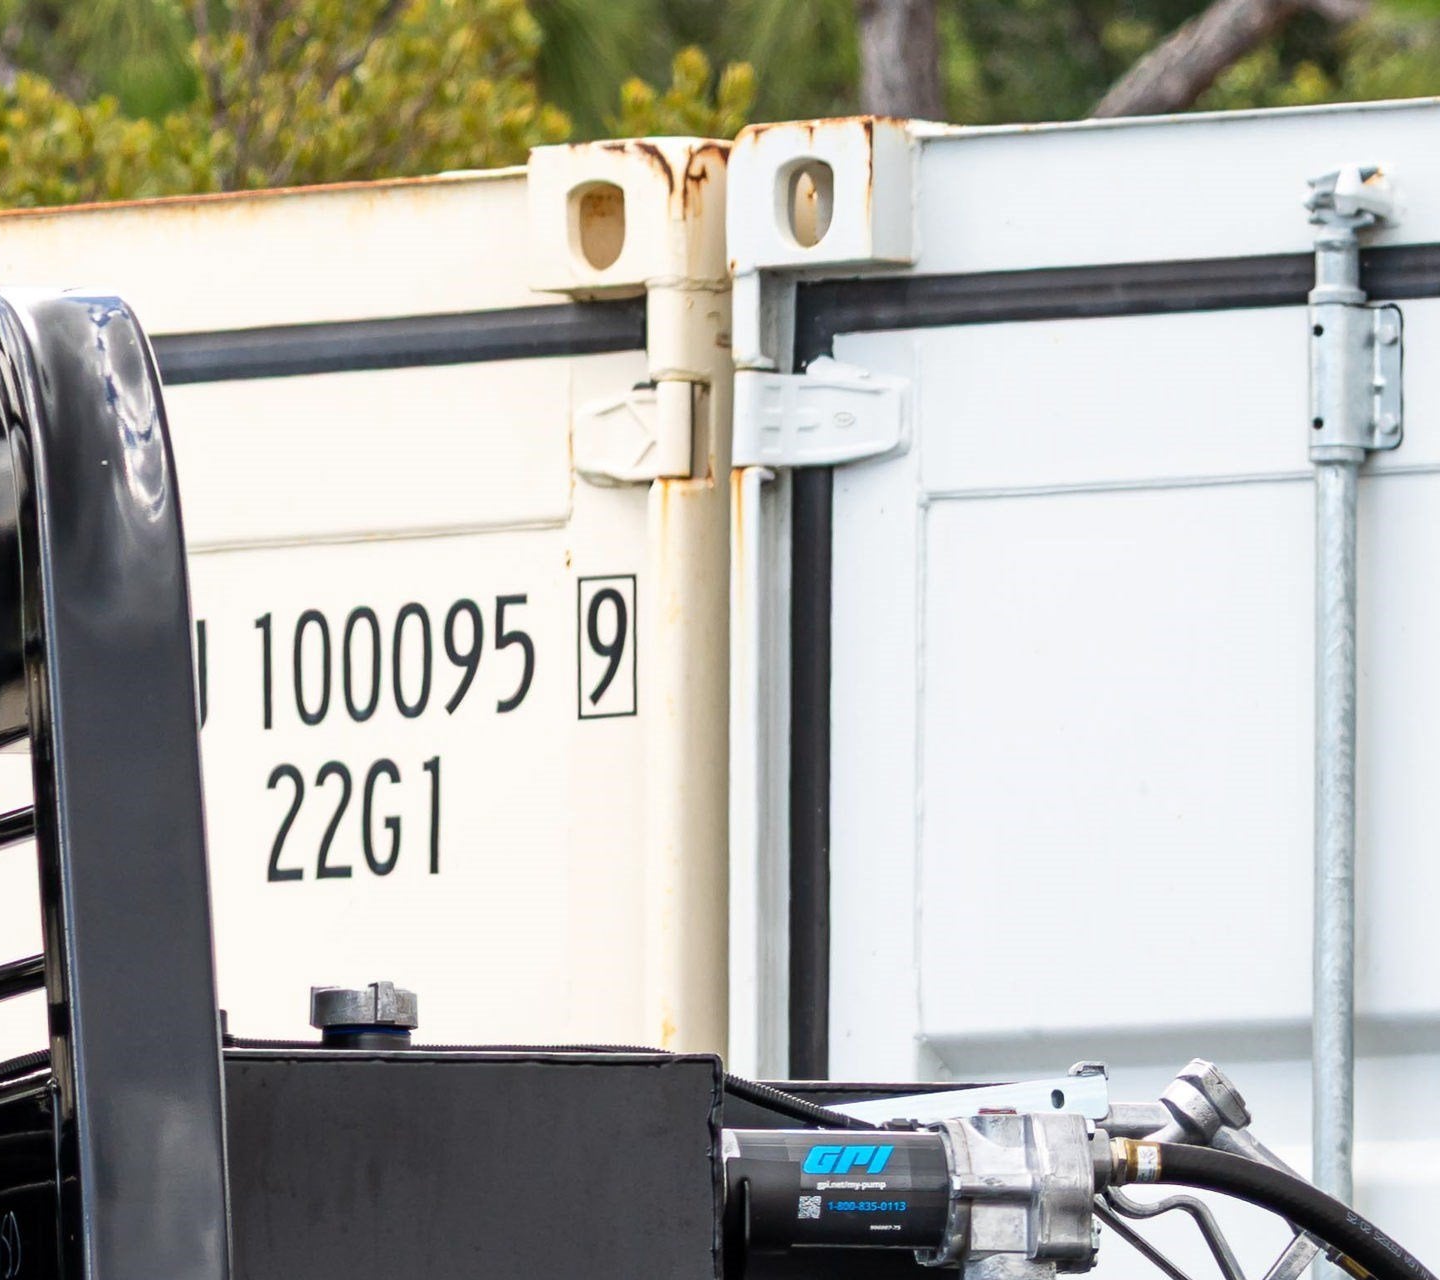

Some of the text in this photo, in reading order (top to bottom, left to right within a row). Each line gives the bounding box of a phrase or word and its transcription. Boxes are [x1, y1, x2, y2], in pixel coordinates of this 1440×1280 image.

[255, 594, 535, 730] 100095
[587, 587, 628, 706] 9
[267, 756, 440, 883] 22G1
[803, 1145, 895, 1174] GPI
[828, 1201, 907, 1211] 1-800-835-0113
